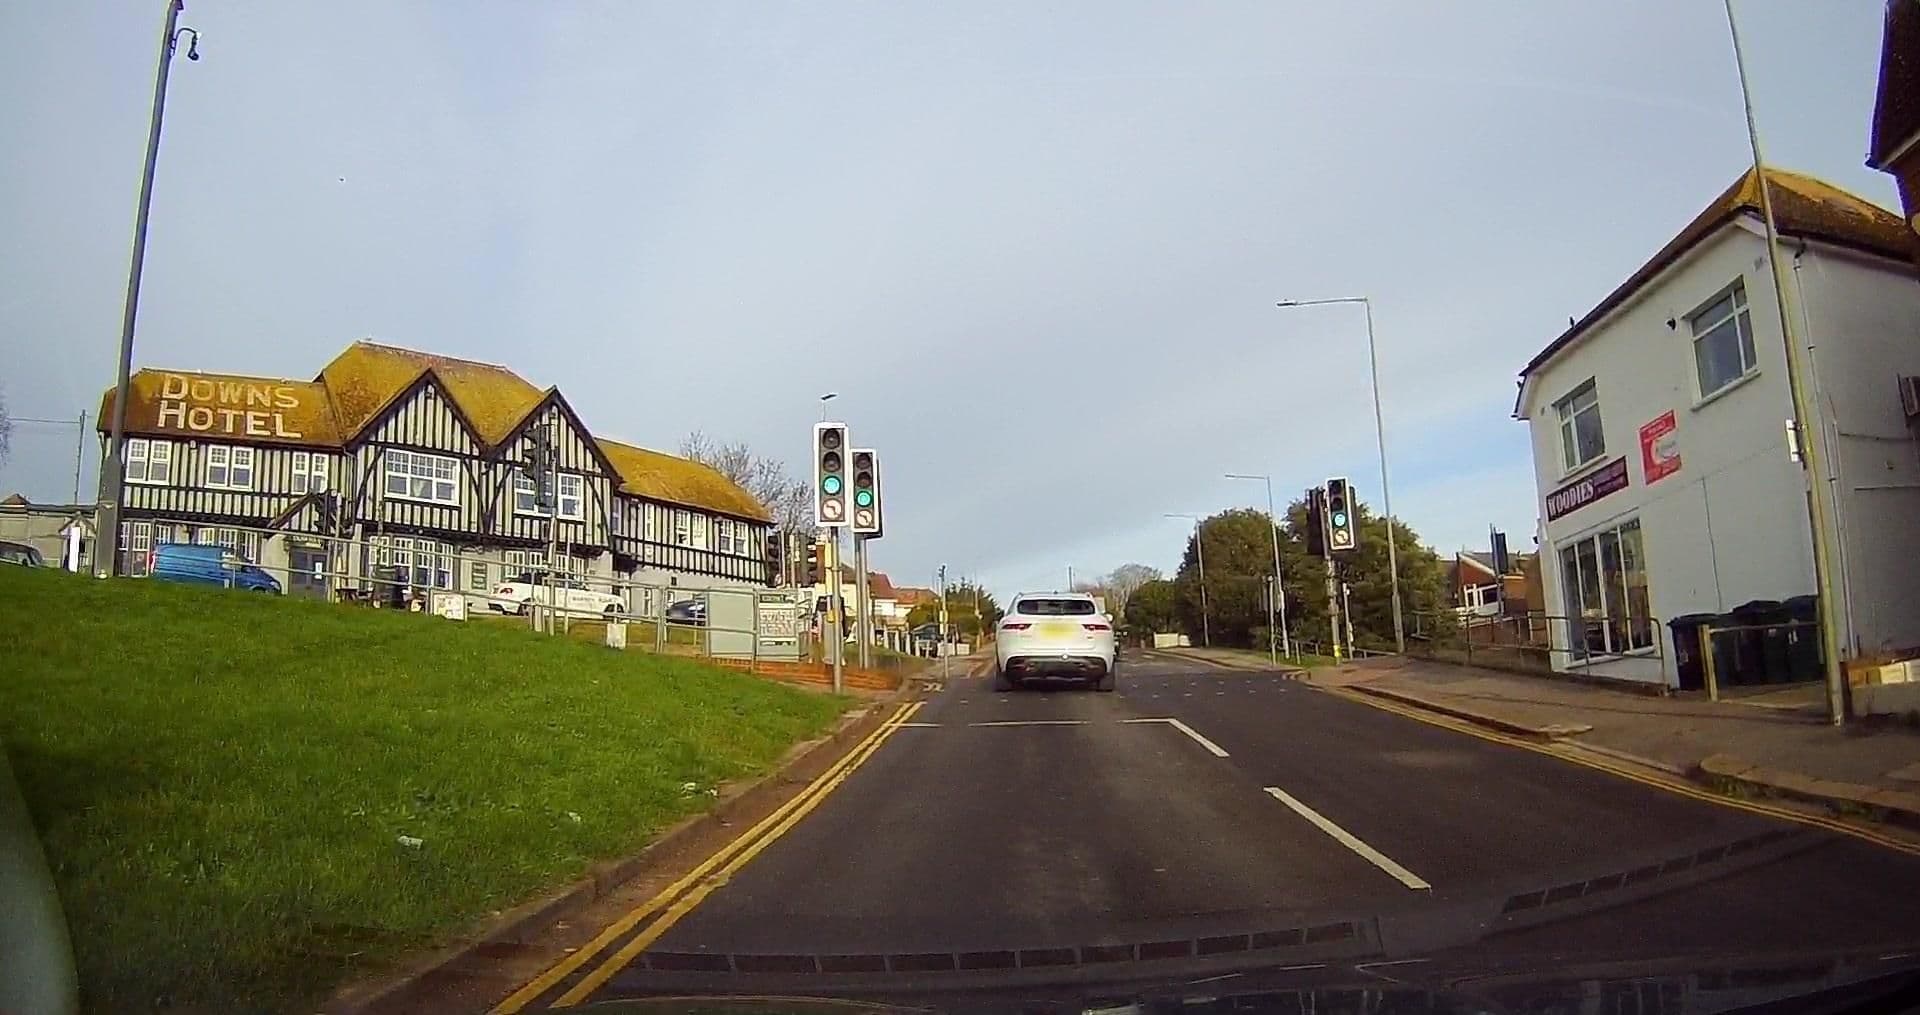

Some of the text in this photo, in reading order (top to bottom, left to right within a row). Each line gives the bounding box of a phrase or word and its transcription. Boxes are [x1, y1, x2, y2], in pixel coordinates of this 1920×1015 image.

[162, 374, 300, 408] DOWNS
[157, 400, 302, 438] HOTEL
[1548, 479, 1594, 515] WOODIES
